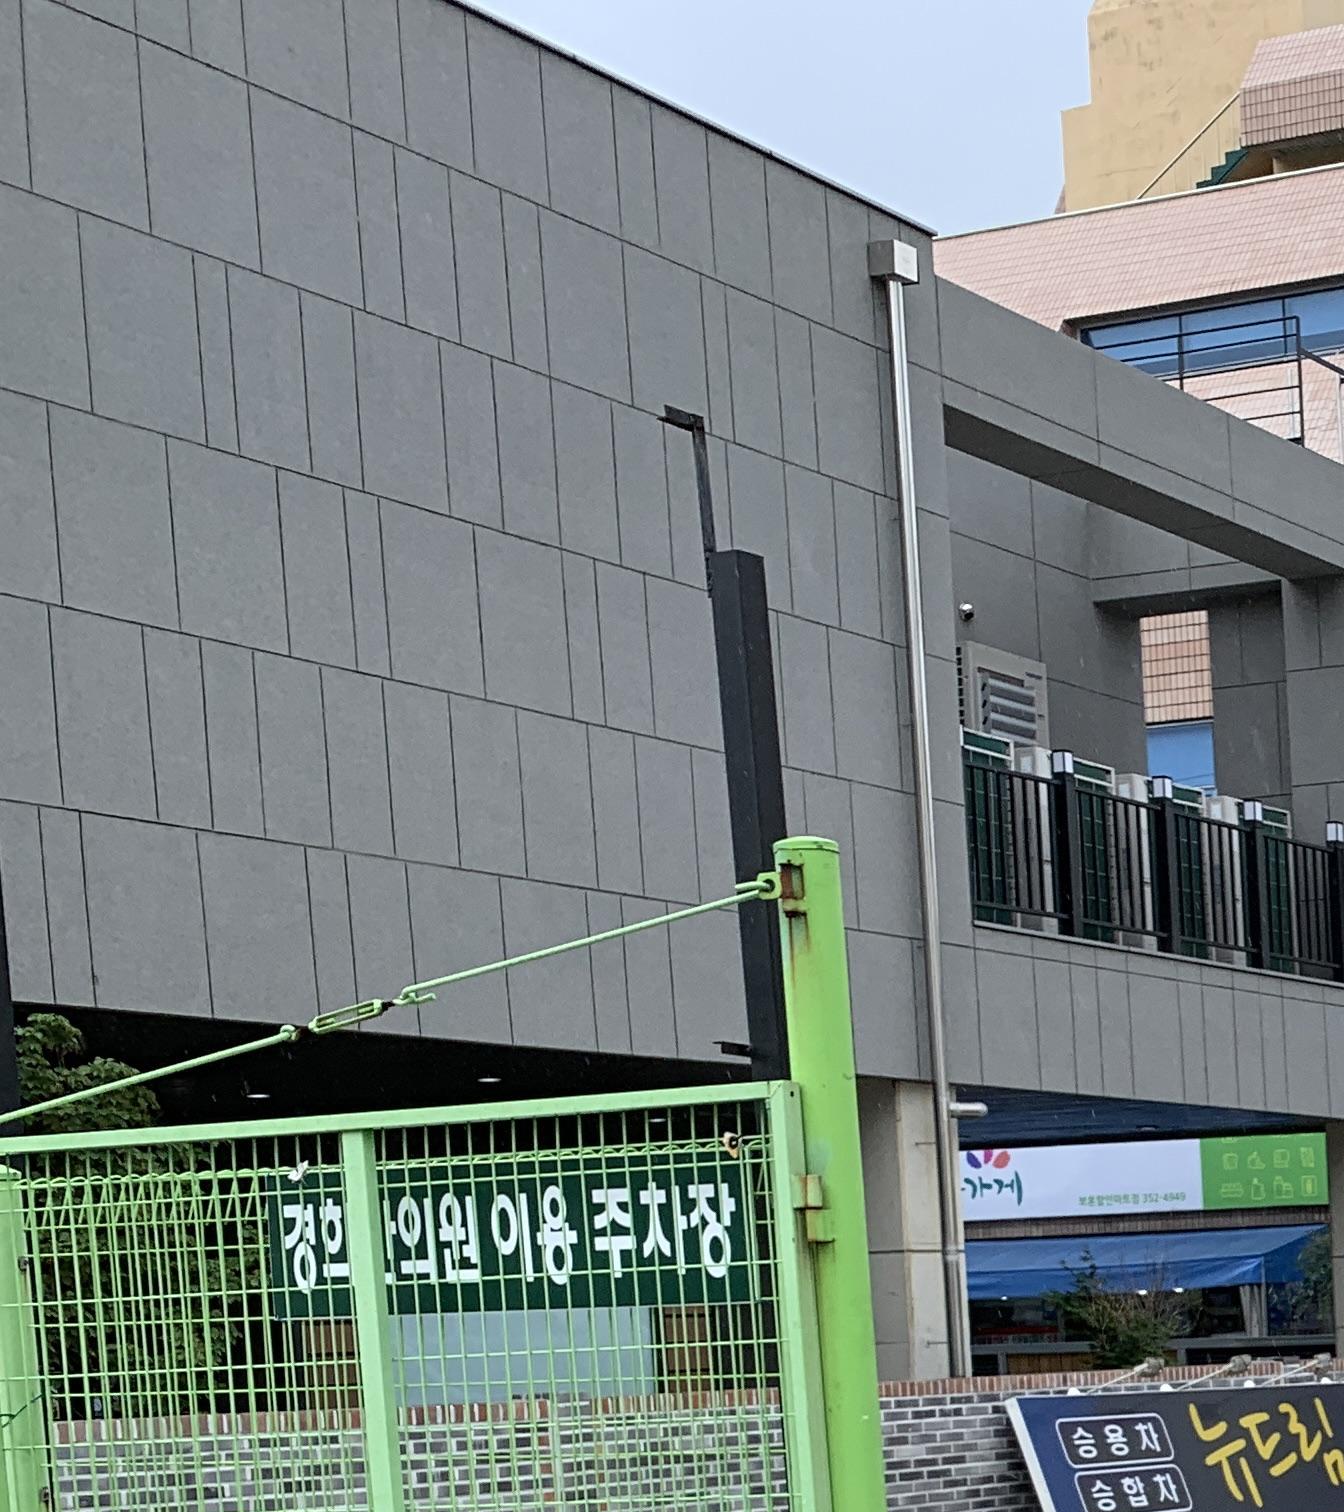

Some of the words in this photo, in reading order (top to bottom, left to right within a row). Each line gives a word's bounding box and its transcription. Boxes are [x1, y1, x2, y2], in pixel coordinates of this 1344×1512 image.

[961, 1170, 1023, 1207] 가게
[490, 1185, 578, 1286] 이용
[591, 1182, 736, 1279] 주차장
[1071, 1421, 1162, 1459] 승용차
[1090, 1472, 1181, 1512] 승합차
